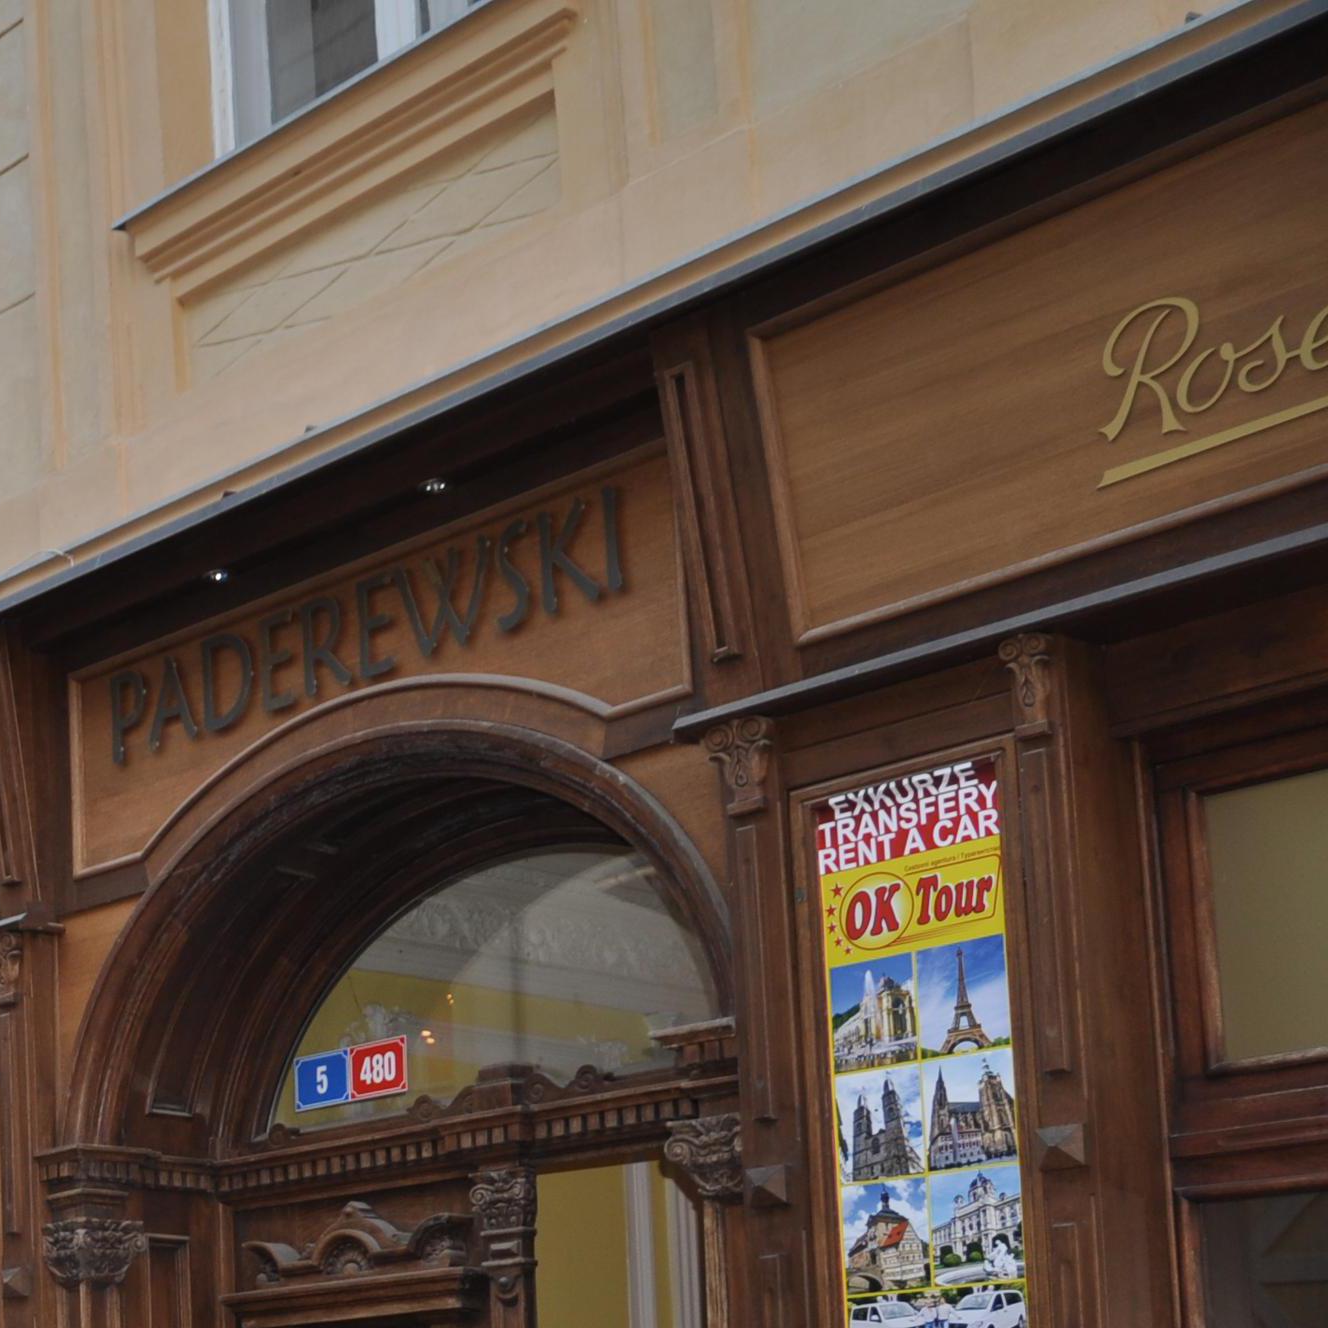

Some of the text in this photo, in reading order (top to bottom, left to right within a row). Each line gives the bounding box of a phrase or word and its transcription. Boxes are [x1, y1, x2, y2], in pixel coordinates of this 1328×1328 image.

[110, 484, 624, 767] PADEREWSKI
[818, 780, 997, 848] TRANSFERY
[828, 761, 979, 820] EXKURZE
[819, 809, 1000, 875] RENT A CAR
[846, 874, 993, 940] OK Tour
[315, 1064, 329, 1096] 5
[359, 1050, 397, 1086] 480
